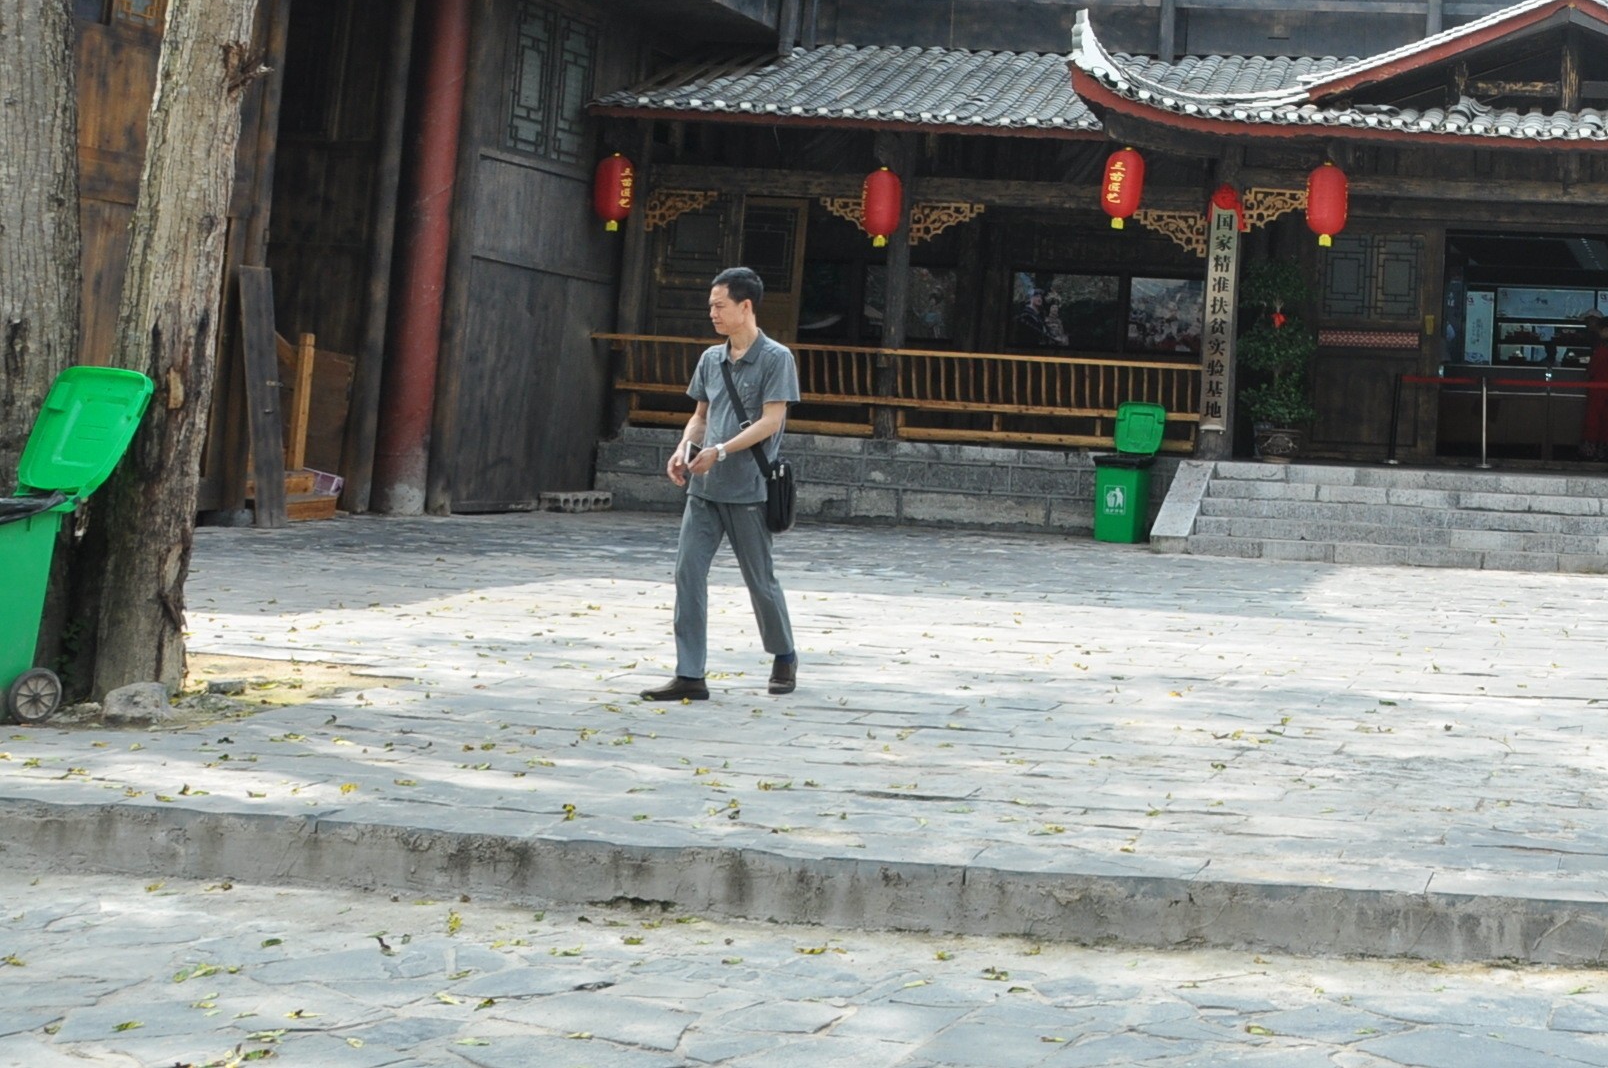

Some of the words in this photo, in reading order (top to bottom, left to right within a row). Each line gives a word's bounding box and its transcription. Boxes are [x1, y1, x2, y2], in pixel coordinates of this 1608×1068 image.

[1203, 213, 1235, 419] 国家精准扶贫实验基地
